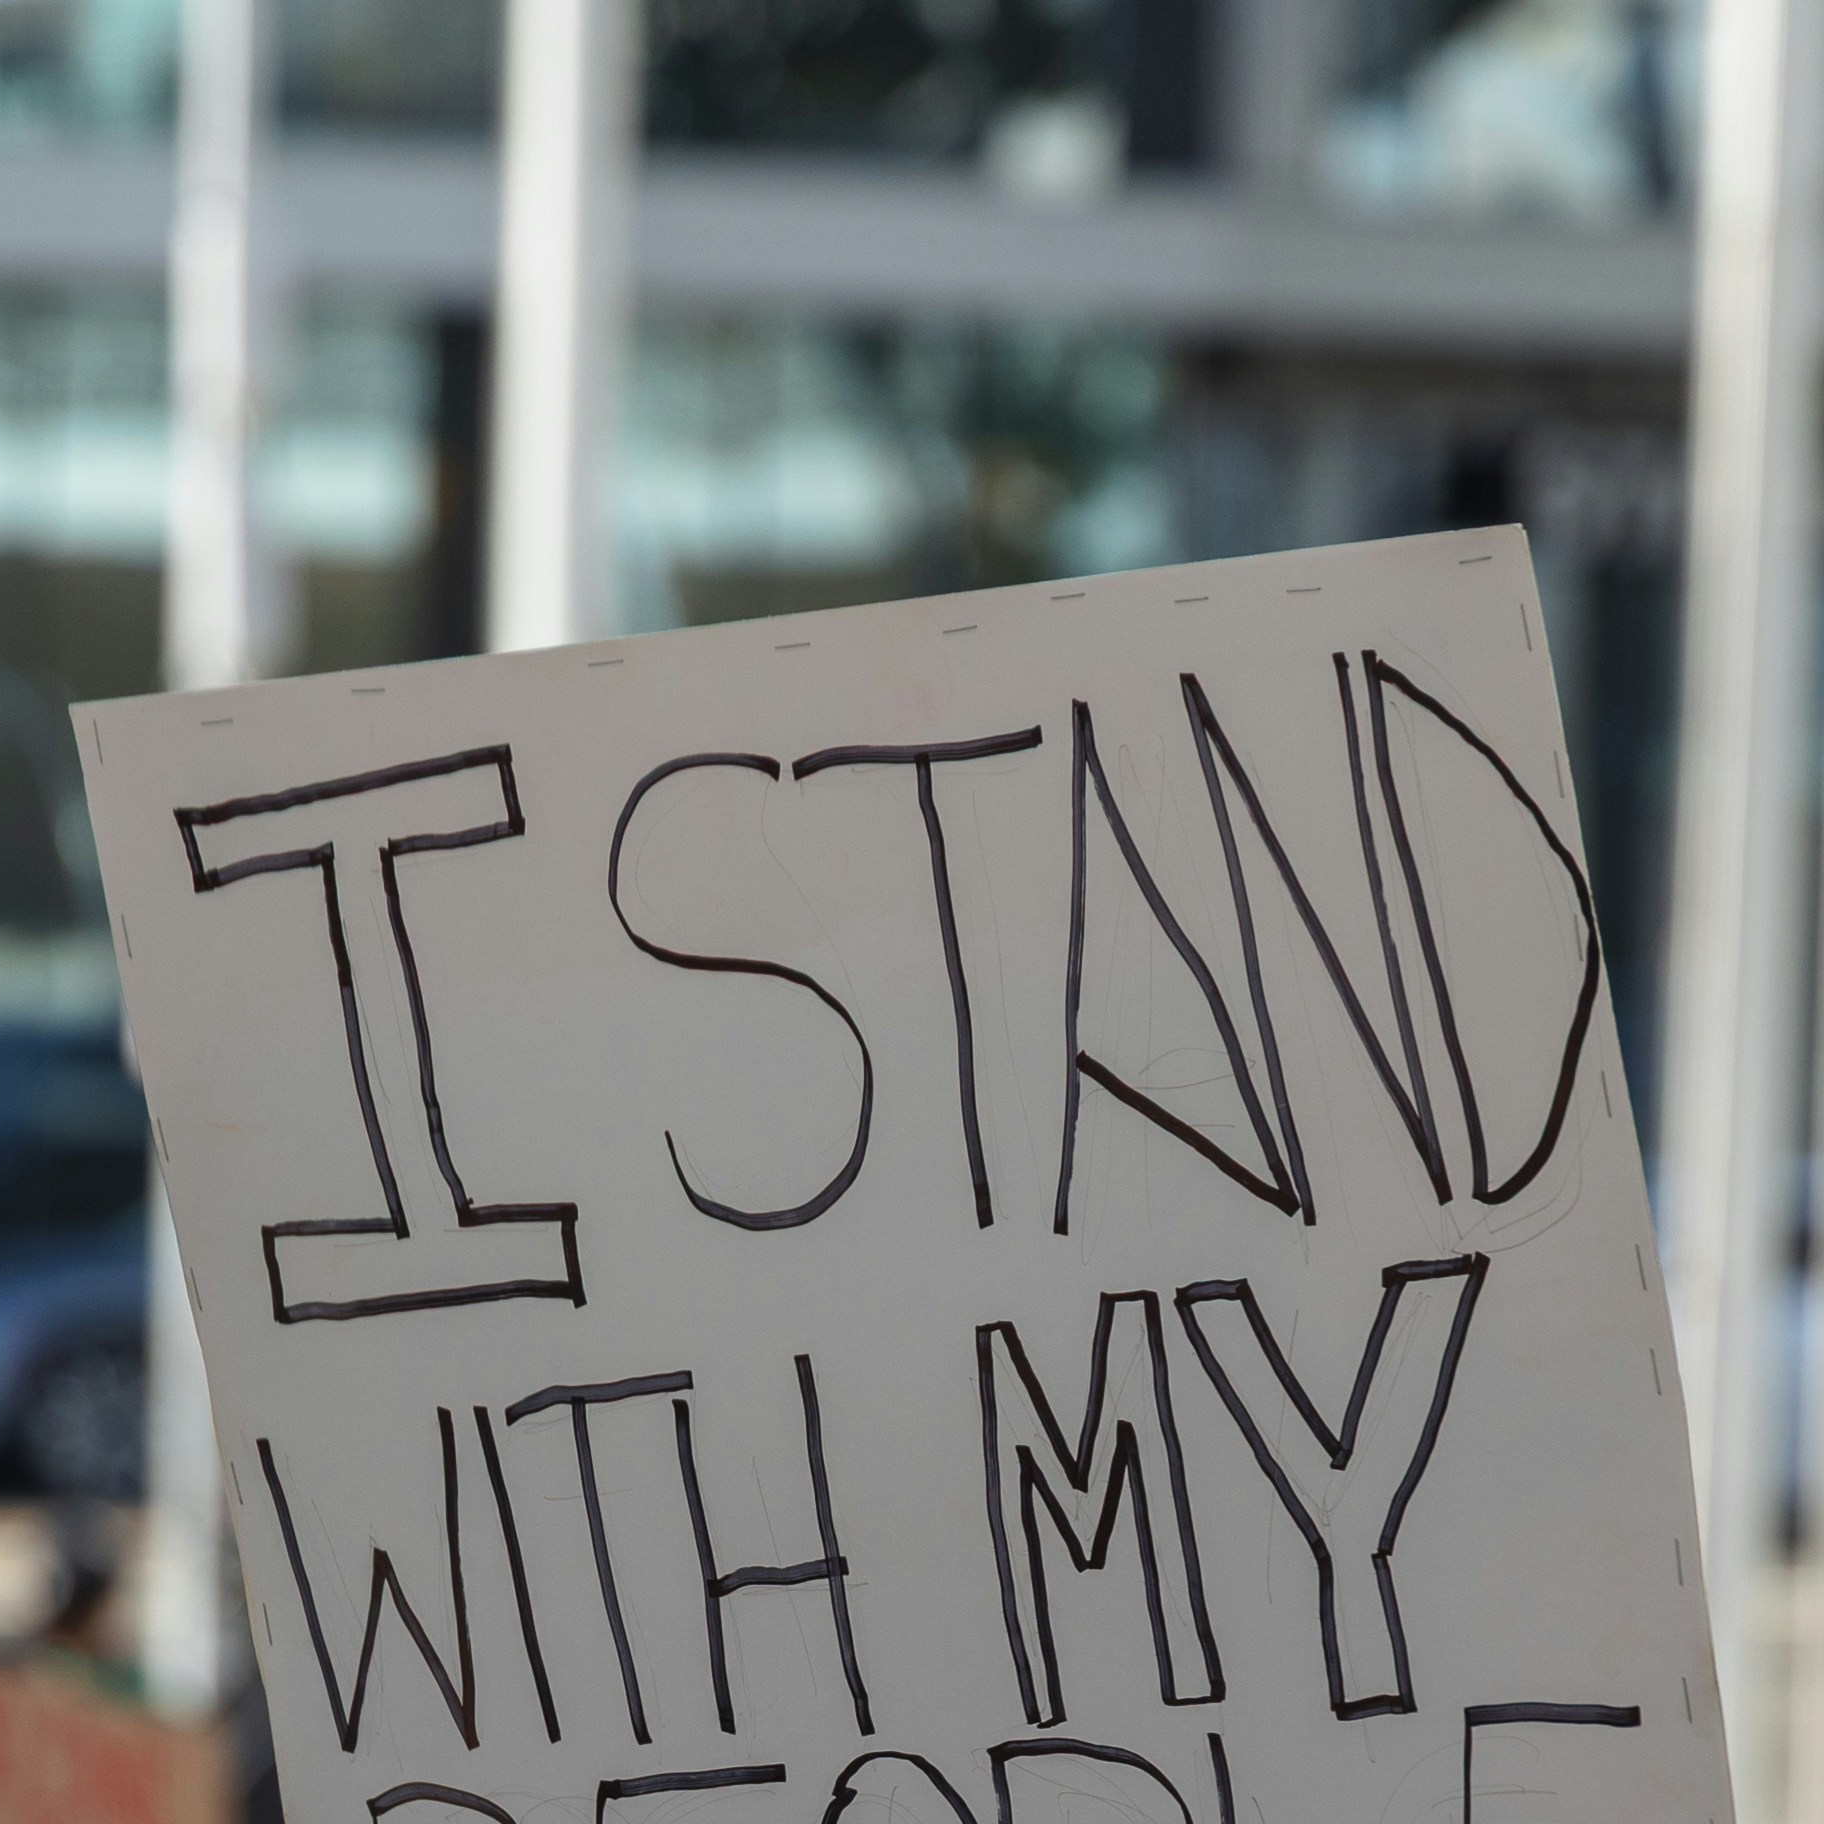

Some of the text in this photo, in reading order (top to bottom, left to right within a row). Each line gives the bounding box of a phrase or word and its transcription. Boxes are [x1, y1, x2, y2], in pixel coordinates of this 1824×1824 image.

[177, 648, 1600, 1322] I STAND
[256, 1251, 1490, 1752] WITH MY
